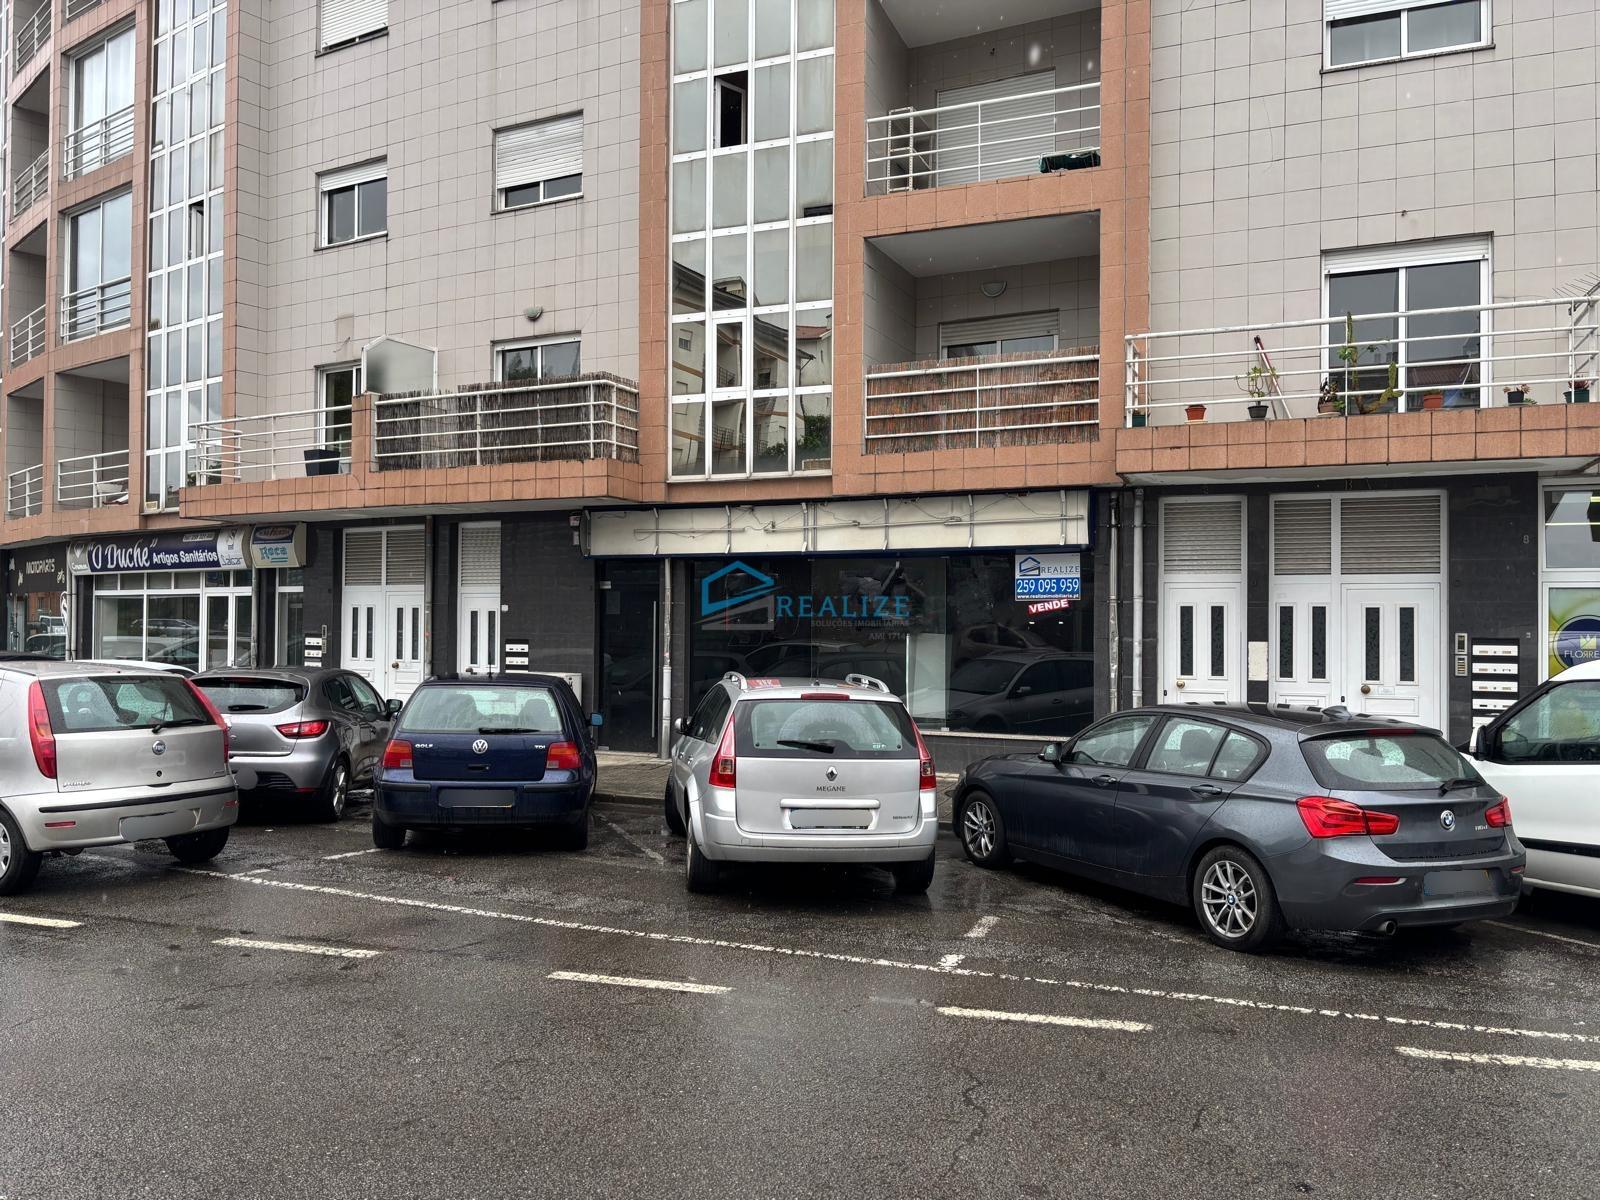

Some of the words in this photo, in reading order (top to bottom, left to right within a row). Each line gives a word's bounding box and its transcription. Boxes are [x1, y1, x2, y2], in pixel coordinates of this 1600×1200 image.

[153, 552, 179, 566] Artigos
[180, 549, 217, 563] Sanitários
[26, 559, 55, 574] MOTORPARTS
[1017, 580, 1035, 593] 259
[1038, 579, 1057, 593] 095
[1060, 578, 1079, 592] 959
[1028, 599, 1069, 614] VENDE
